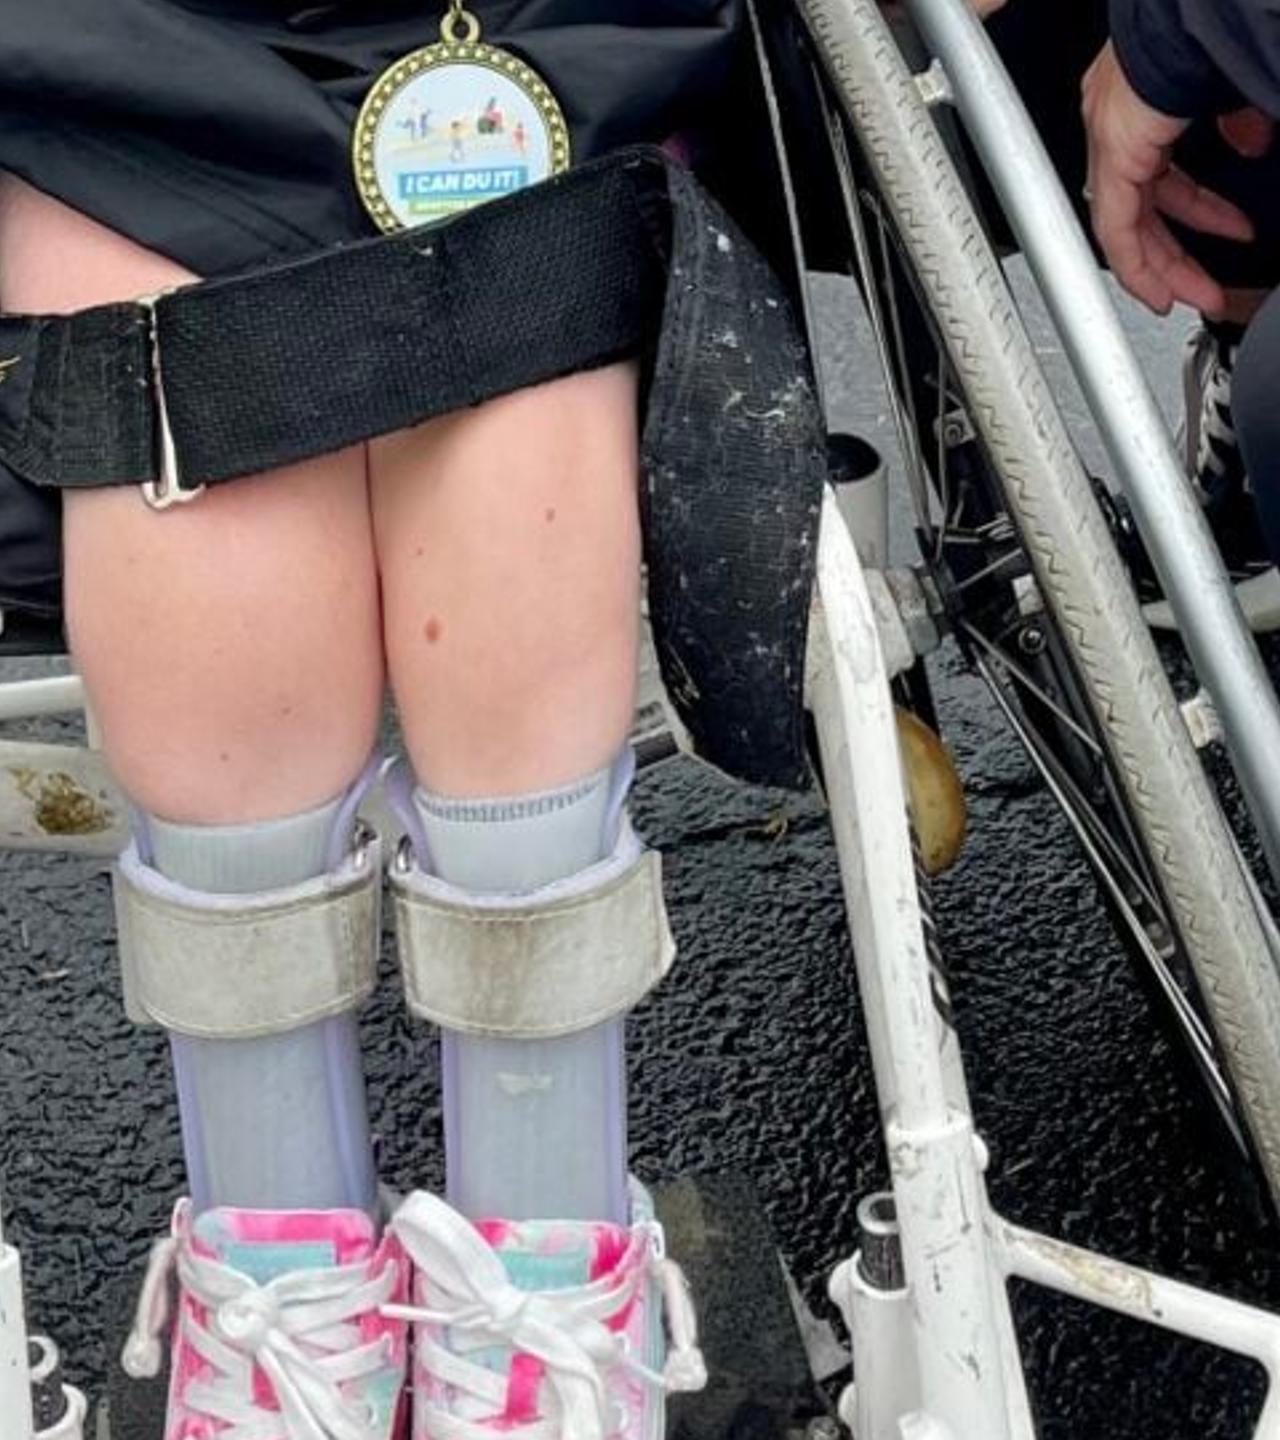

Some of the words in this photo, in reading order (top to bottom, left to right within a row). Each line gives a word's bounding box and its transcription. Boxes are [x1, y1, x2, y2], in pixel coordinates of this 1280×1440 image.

[405, 174, 413, 193] I
[417, 172, 459, 193] CAN
[463, 171, 490, 192] DU
